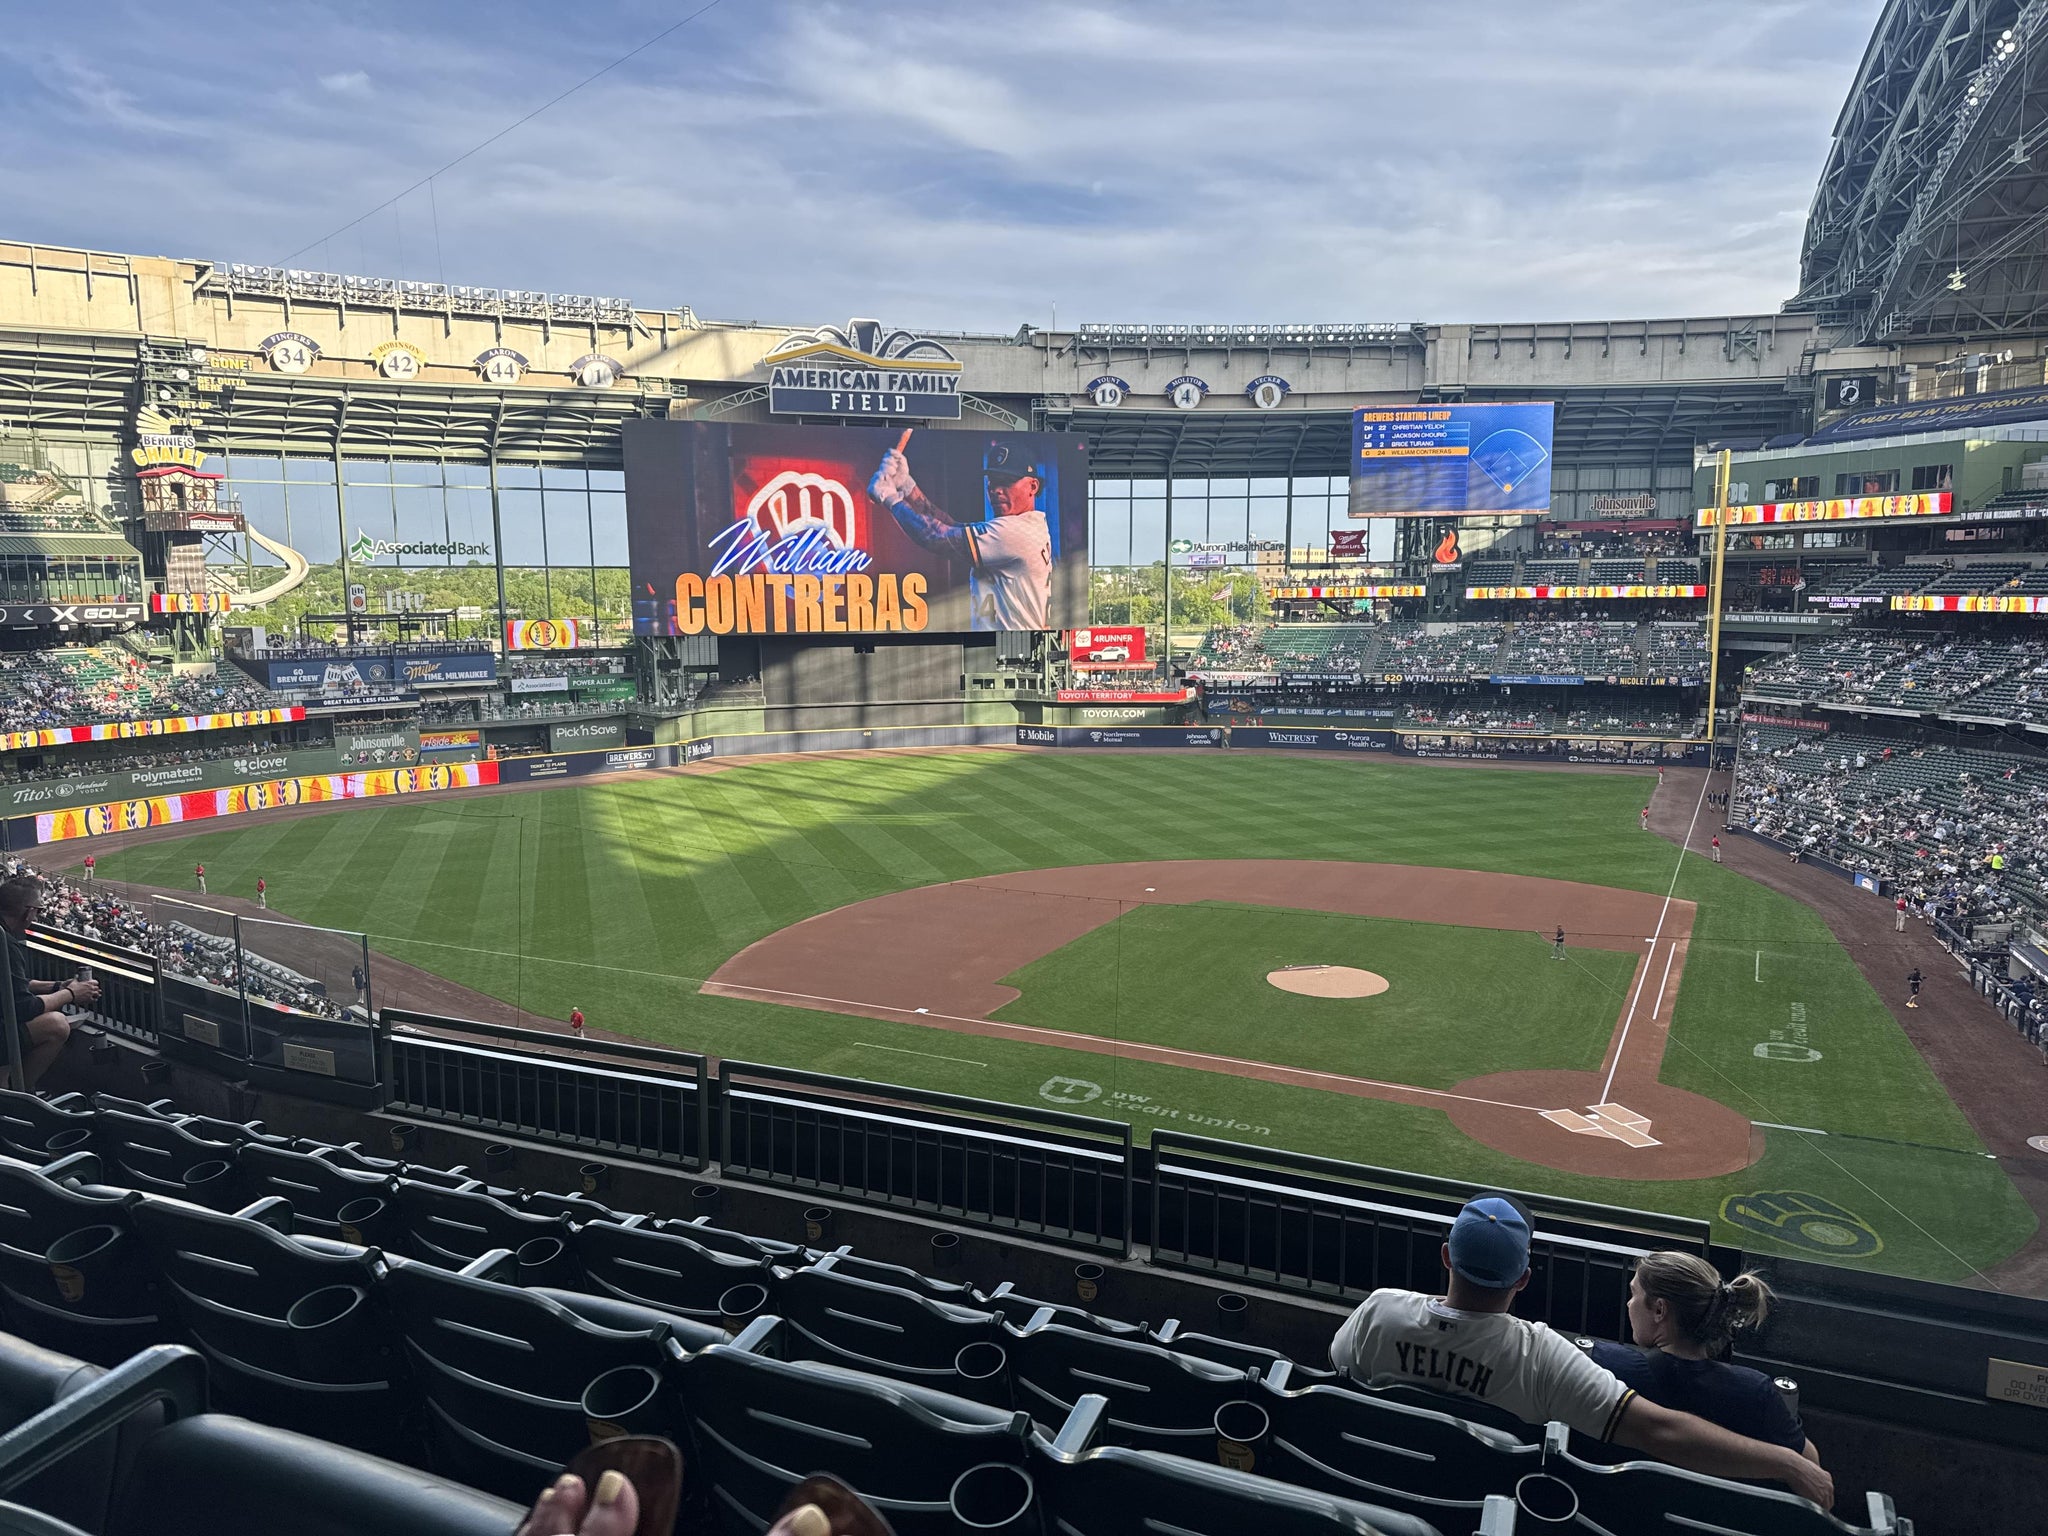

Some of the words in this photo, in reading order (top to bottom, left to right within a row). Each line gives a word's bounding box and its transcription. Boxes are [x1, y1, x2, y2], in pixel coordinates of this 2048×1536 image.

[269, 331, 312, 346] FINGERS
[378, 341, 420, 355] ROBINSON
[489, 349, 516, 359] AARON
[279, 347, 306, 366] 34
[585, 354, 609, 363] SELIG
[210, 356, 253, 371] GONE!
[388, 355, 413, 373] 42
[491, 361, 514, 379] 44
[197, 376, 215, 386] GET
[218, 377, 247, 388] OUTTA
[593, 368, 602, 385] 1
[771, 368, 880, 390] AMERICAN
[888, 374, 959, 393] FAMILY
[1097, 376, 1120, 385] YOUNT
[1171, 376, 1203, 387] MOLITOR
[1254, 375, 1282, 385] UECKER
[197, 384, 223, 393] HERE
[1099, 388, 1117, 403] 19
[1180, 389, 1191, 403] 4
[177, 400, 193, 409] GET
[196, 401, 212, 410] UP
[831, 393, 906, 412] FIELD
[1363, 412, 1395, 422] BREWERS
[1395, 411, 1428, 422] STARTING
[1428, 411, 1452, 421] LINEUP
[1857, 414, 1898, 425] MUST
[1899, 411, 1921, 420] BE
[1923, 408, 1942, 416] IN
[1944, 403, 1974, 413] THE
[1974, 397, 2034, 410] FRONT
[168, 417, 187, 426] GET
[189, 418, 204, 427] UP
[143, 435, 195, 447] BERNIE'S
[131, 445, 208, 469] CHALET
[1590, 494, 1656, 511] Johnsonville
[1961, 512, 1967, 520] TO
[1967, 511, 1983, 520] REPORT
[1983, 511, 1993, 520] FAN
[1993, 510, 2023, 519] MISCONDUCT:
[2025, 509, 2036, 517] TEXT
[708, 518, 873, 577] William
[1197, 541, 1227, 552] Aurora
[1230, 541, 1260, 552] Health
[1263, 541, 1284, 552] Care
[351, 585, 365, 595] Lite
[386, 590, 426, 613] Lite
[675, 572, 929, 635] CONTRERAS
[50, 606, 79, 622] X
[83, 607, 141, 620] GOLF
[1093, 634, 1133, 643] 4RUNNER
[293, 668, 303, 676] GO
[403, 662, 442, 681] Miller
[423, 673, 444, 682] TIME,
[445, 670, 489, 680] MILWAUKEE
[277, 675, 298, 684] BREW
[298, 674, 319, 683] CREW
[1384, 674, 1403, 682] 620
[1404, 674, 1434, 682] WTMJ
[1538, 675, 1580, 684] WINTRUST
[1620, 677, 1648, 686] NICOLET
[1650, 677, 1666, 686] LAW
[323, 698, 342, 706] GREAT
[1060, 692, 1090, 700] TOYOTA
[1091, 692, 1134, 700] TERRITORY
[1082, 709, 1146, 719] TOYOTA.COM
[1303, 708, 1324, 716] DELICIOUS
[1345, 709, 1366, 717] WELCOME
[590, 724, 617, 736] Save
[1027, 730, 1055, 741] Mobile
[350, 734, 405, 751] Johnsonville
[1268, 731, 1318, 743] WINTRUST
[1348, 734, 1370, 742] Aurora
[693, 743, 712, 757] Mobile
[1348, 740, 1370, 748] Health
[249, 757, 288, 770] clover
[609, 752, 652, 763] BREWERS.TV
[131, 766, 203, 784] Polymatech
[75, 779, 109, 792] Handmade
[80, 787, 105, 795] VODKA
[13, 786, 53, 805] Tito's
[1110, 1090, 1152, 1103] uw
[1102, 1099, 1180, 1119] credit
[1187, 1113, 1272, 1136] union
[1395, 1340, 1494, 1397] YELICH
[2010, 1380, 2026, 1390] DO
[2004, 1388, 2020, 1398] OR
[2023, 1391, 2048, 1403] OVE
